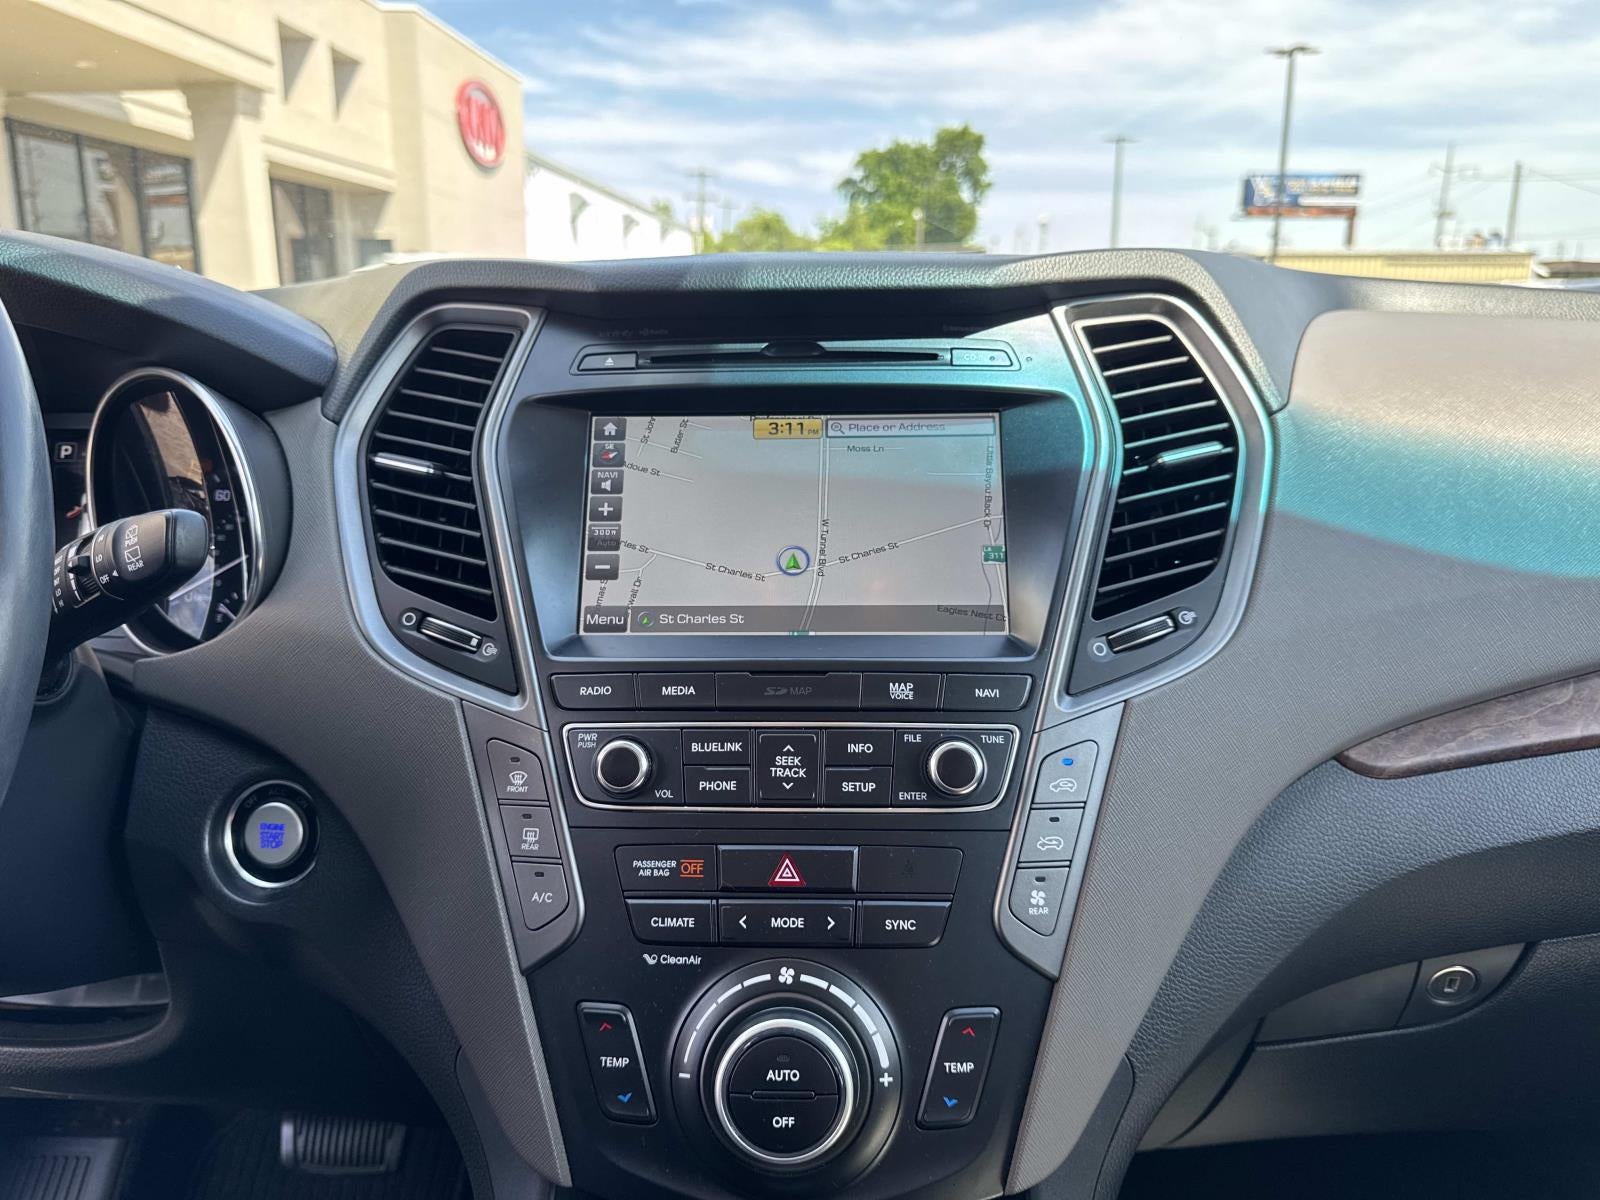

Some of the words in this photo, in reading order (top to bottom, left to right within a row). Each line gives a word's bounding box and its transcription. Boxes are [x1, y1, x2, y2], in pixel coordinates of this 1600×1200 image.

[768, 423, 804, 435] 3:11
[848, 423, 880, 432] Place
[883, 424, 896, 432] or
[898, 423, 946, 432] Address
[60, 446, 73, 459] P
[847, 445, 870, 453] Moss
[873, 445, 884, 453] Ln
[650, 468, 661, 477] St
[983, 469, 994, 493] Bayou
[214, 488, 231, 501] 60
[983, 496, 993, 518] Black
[820, 528, 829, 557] Tunnel
[639, 545, 650, 554] St
[838, 555, 850, 564] St
[851, 546, 886, 561] Charles
[887, 541, 899, 550] St
[127, 561, 144, 572] REAR
[818, 558, 827, 577] Blvd
[705, 562, 716, 571] St
[717, 565, 753, 579] Charles
[755, 573, 766, 582] St
[586, 613, 625, 625] Menu
[659, 613, 675, 624] St
[677, 613, 727, 624] Charles
[729, 613, 745, 624] St
[579, 686, 612, 696] RADIO
[661, 686, 696, 696] MEDIA
[790, 686, 812, 695] MAP
[889, 682, 914, 692] MAP
[890, 691, 914, 700] VOICE
[975, 688, 1000, 698] NAVI
[578, 733, 598, 741] PWR
[904, 734, 922, 743] FILE
[981, 735, 1005, 744] TUNE
[691, 742, 743, 752] BLUELINK
[847, 743, 874, 753] INFO
[775, 756, 801, 766] SEEK
[770, 768, 807, 778] TRACK
[506, 785, 529, 793] FRONT
[699, 781, 737, 791] PHONE
[841, 782, 876, 792] SETUP
[654, 789, 674, 798] VOL
[899, 792, 927, 801] ENTER
[632, 860, 677, 868] PASSENGER
[680, 863, 704, 874] OFF
[638, 869, 652, 877] AIR
[653, 869, 670, 877] BAG
[531, 892, 553, 903] A/C
[1028, 907, 1049, 916] REAR
[651, 917, 695, 927] CLIMATE
[771, 917, 805, 928] MODE
[885, 919, 916, 930] SYNC
[660, 955, 702, 965] CleanAir
[600, 1056, 629, 1068] TEMP
[943, 1062, 975, 1074] TEMP
[766, 1069, 800, 1081] AUTO
[772, 1116, 795, 1128] OFF
